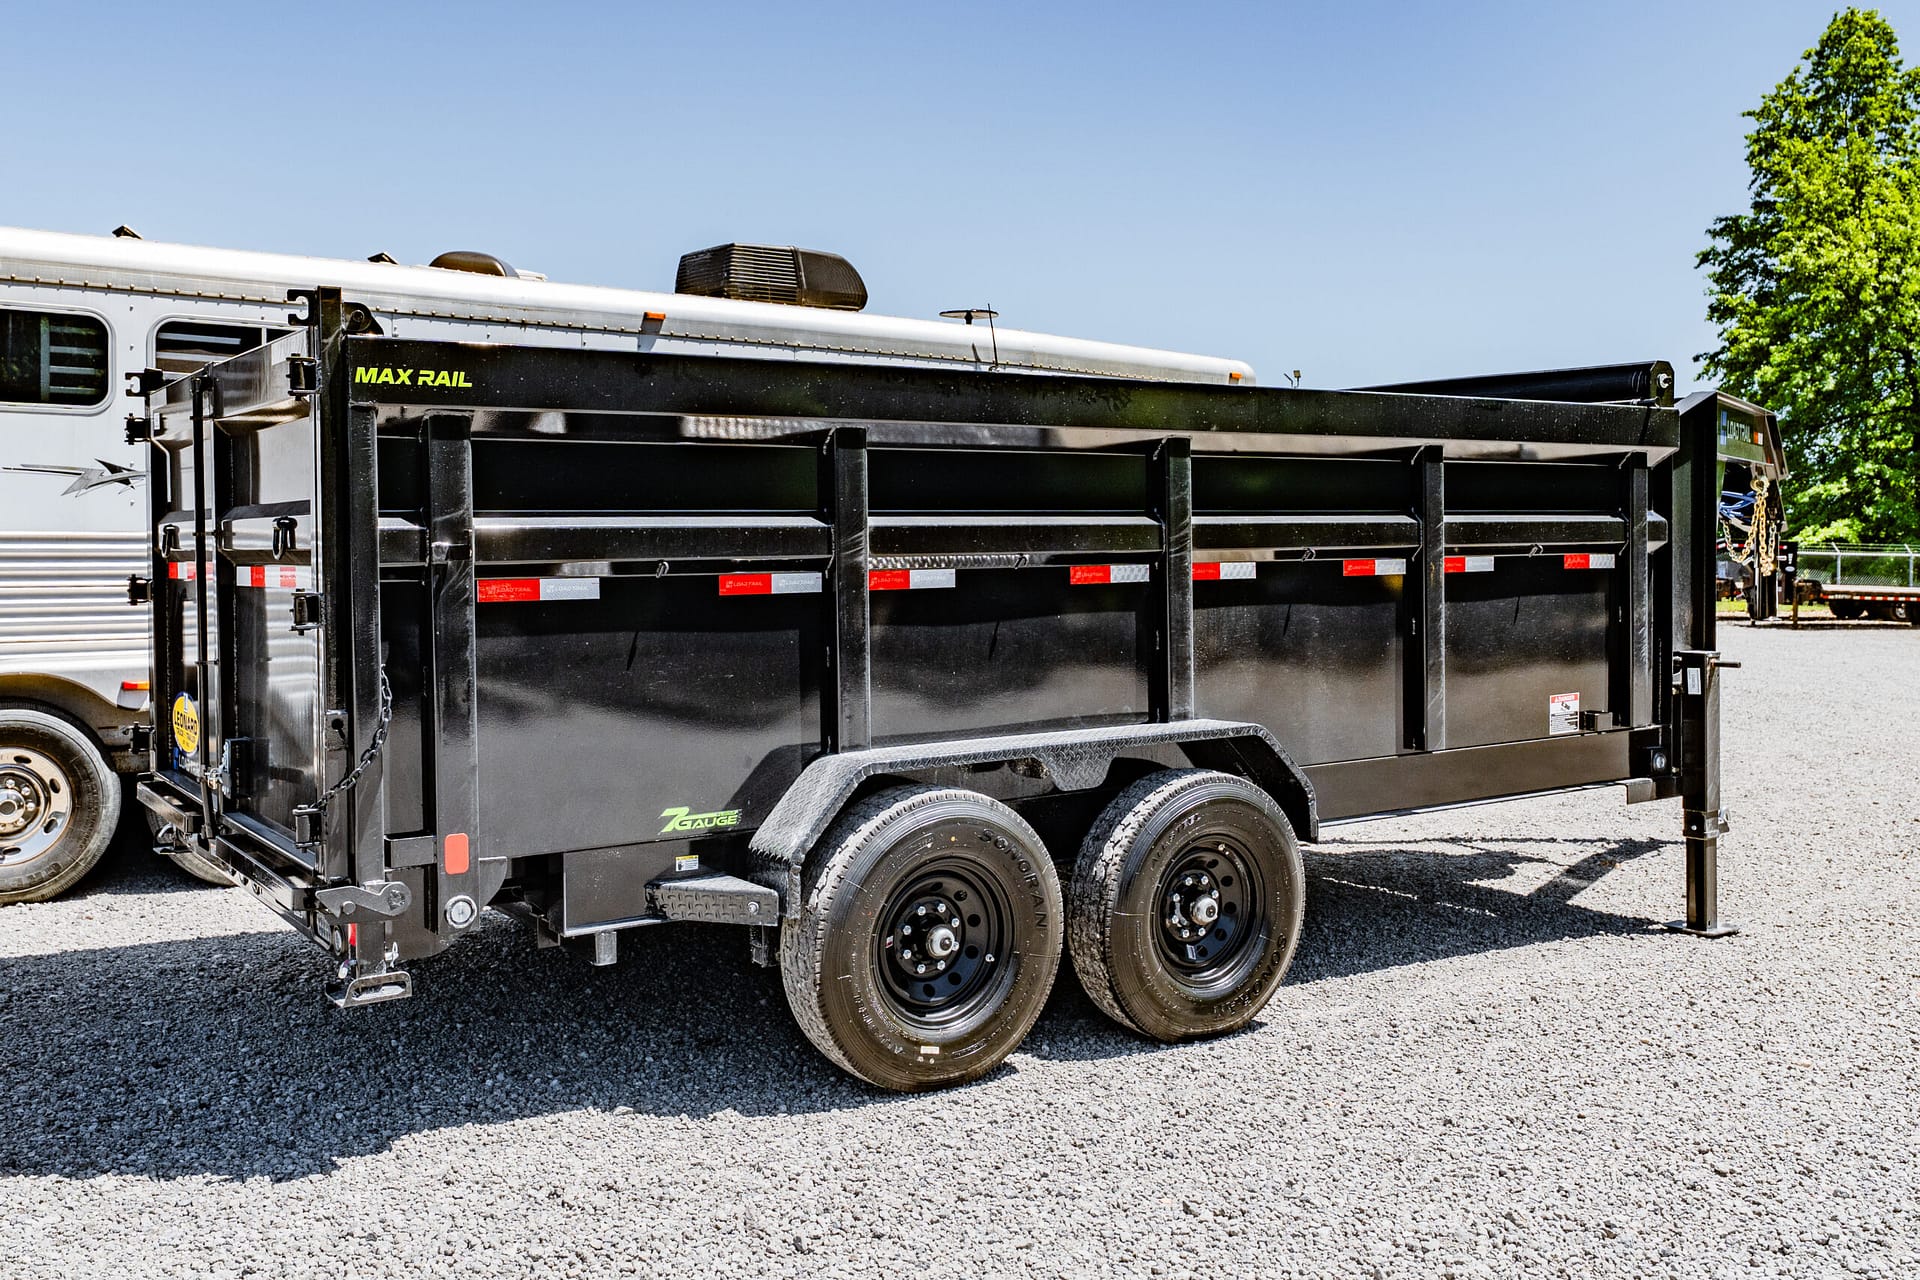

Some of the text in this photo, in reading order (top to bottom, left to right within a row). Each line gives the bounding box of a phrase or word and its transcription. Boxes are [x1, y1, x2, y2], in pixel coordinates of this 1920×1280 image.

[354, 366, 473, 388] MAX RAIL
[657, 806, 739, 835] 7 GAUGE
[979, 828, 1049, 929] SONORAN
